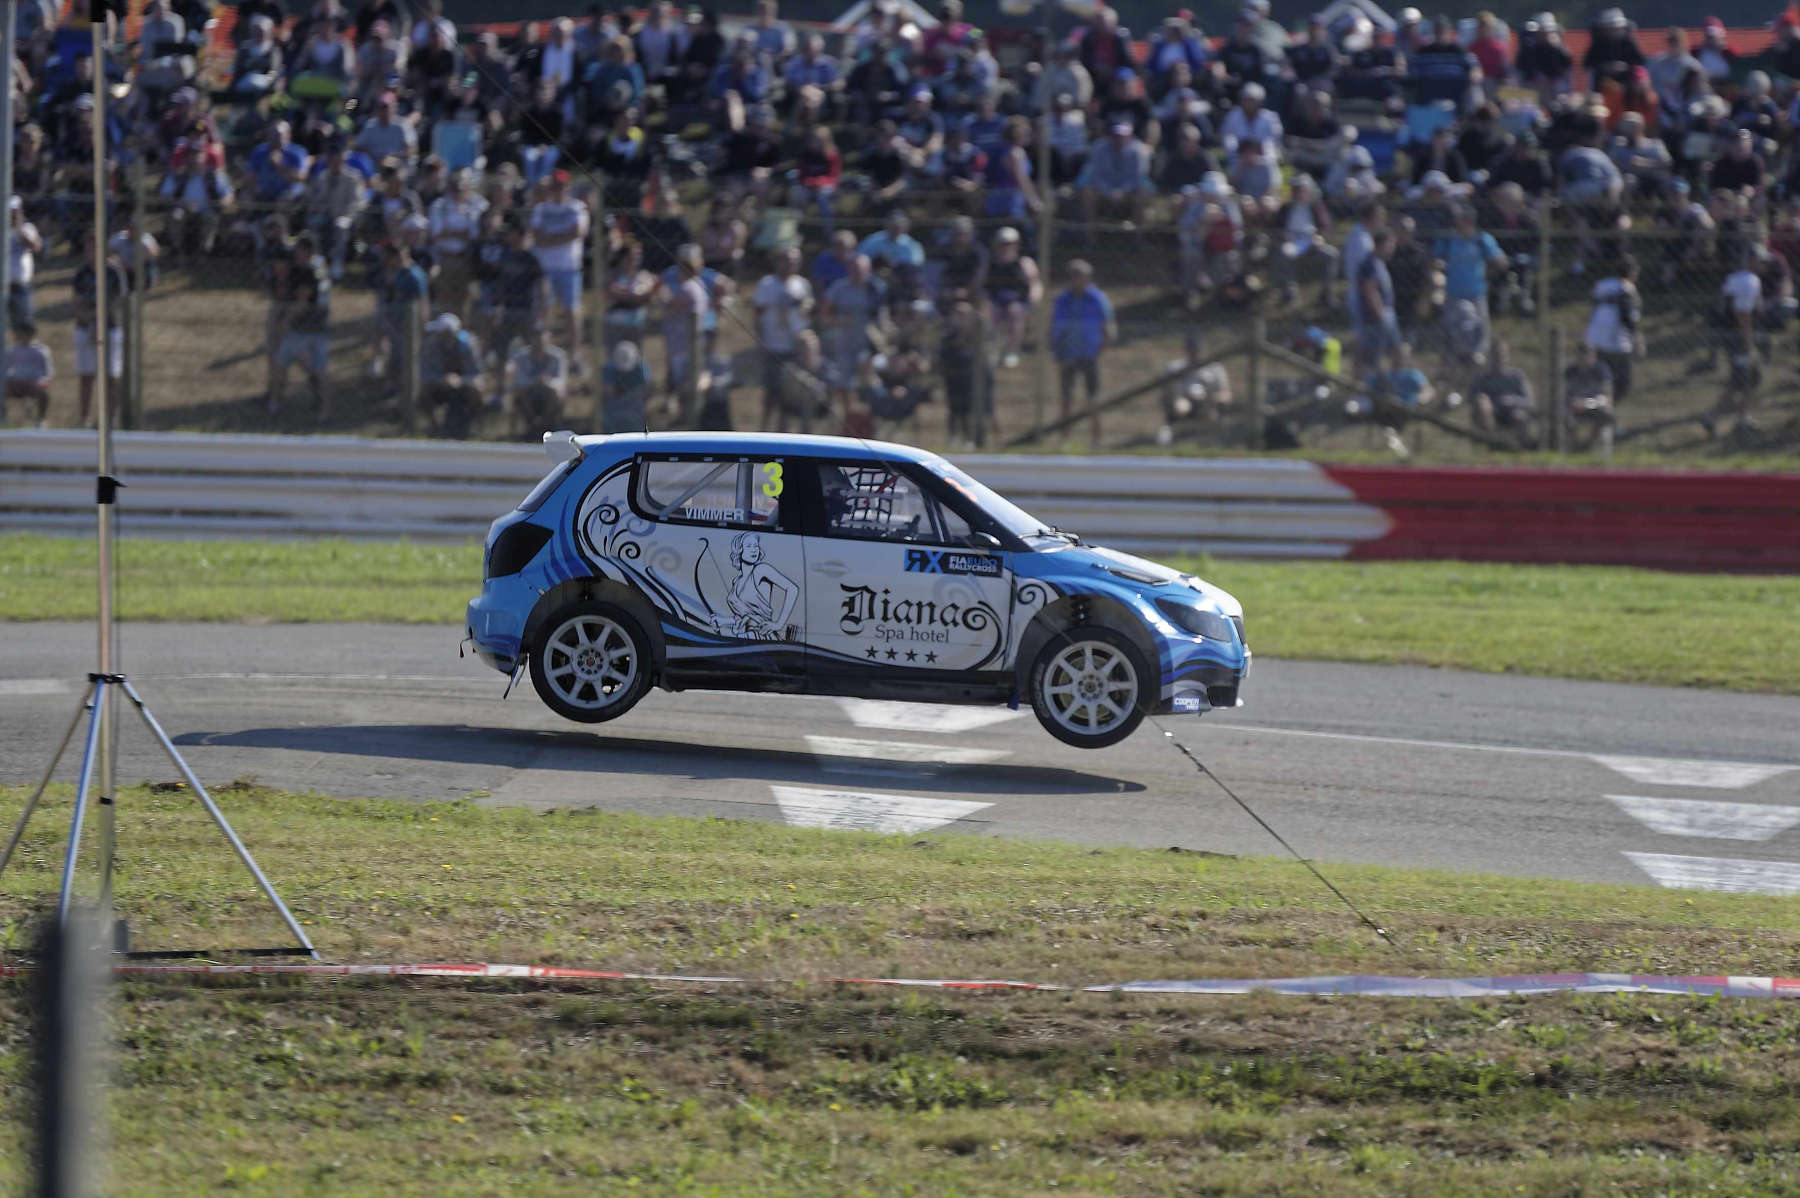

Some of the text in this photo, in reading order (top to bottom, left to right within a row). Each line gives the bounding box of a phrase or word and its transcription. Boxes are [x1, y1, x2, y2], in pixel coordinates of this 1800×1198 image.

[762, 461, 784, 497] 3
[685, 506, 745, 521] VIMMER
[840, 583, 960, 635] Diana
[875, 624, 950, 644] Spa hotel
